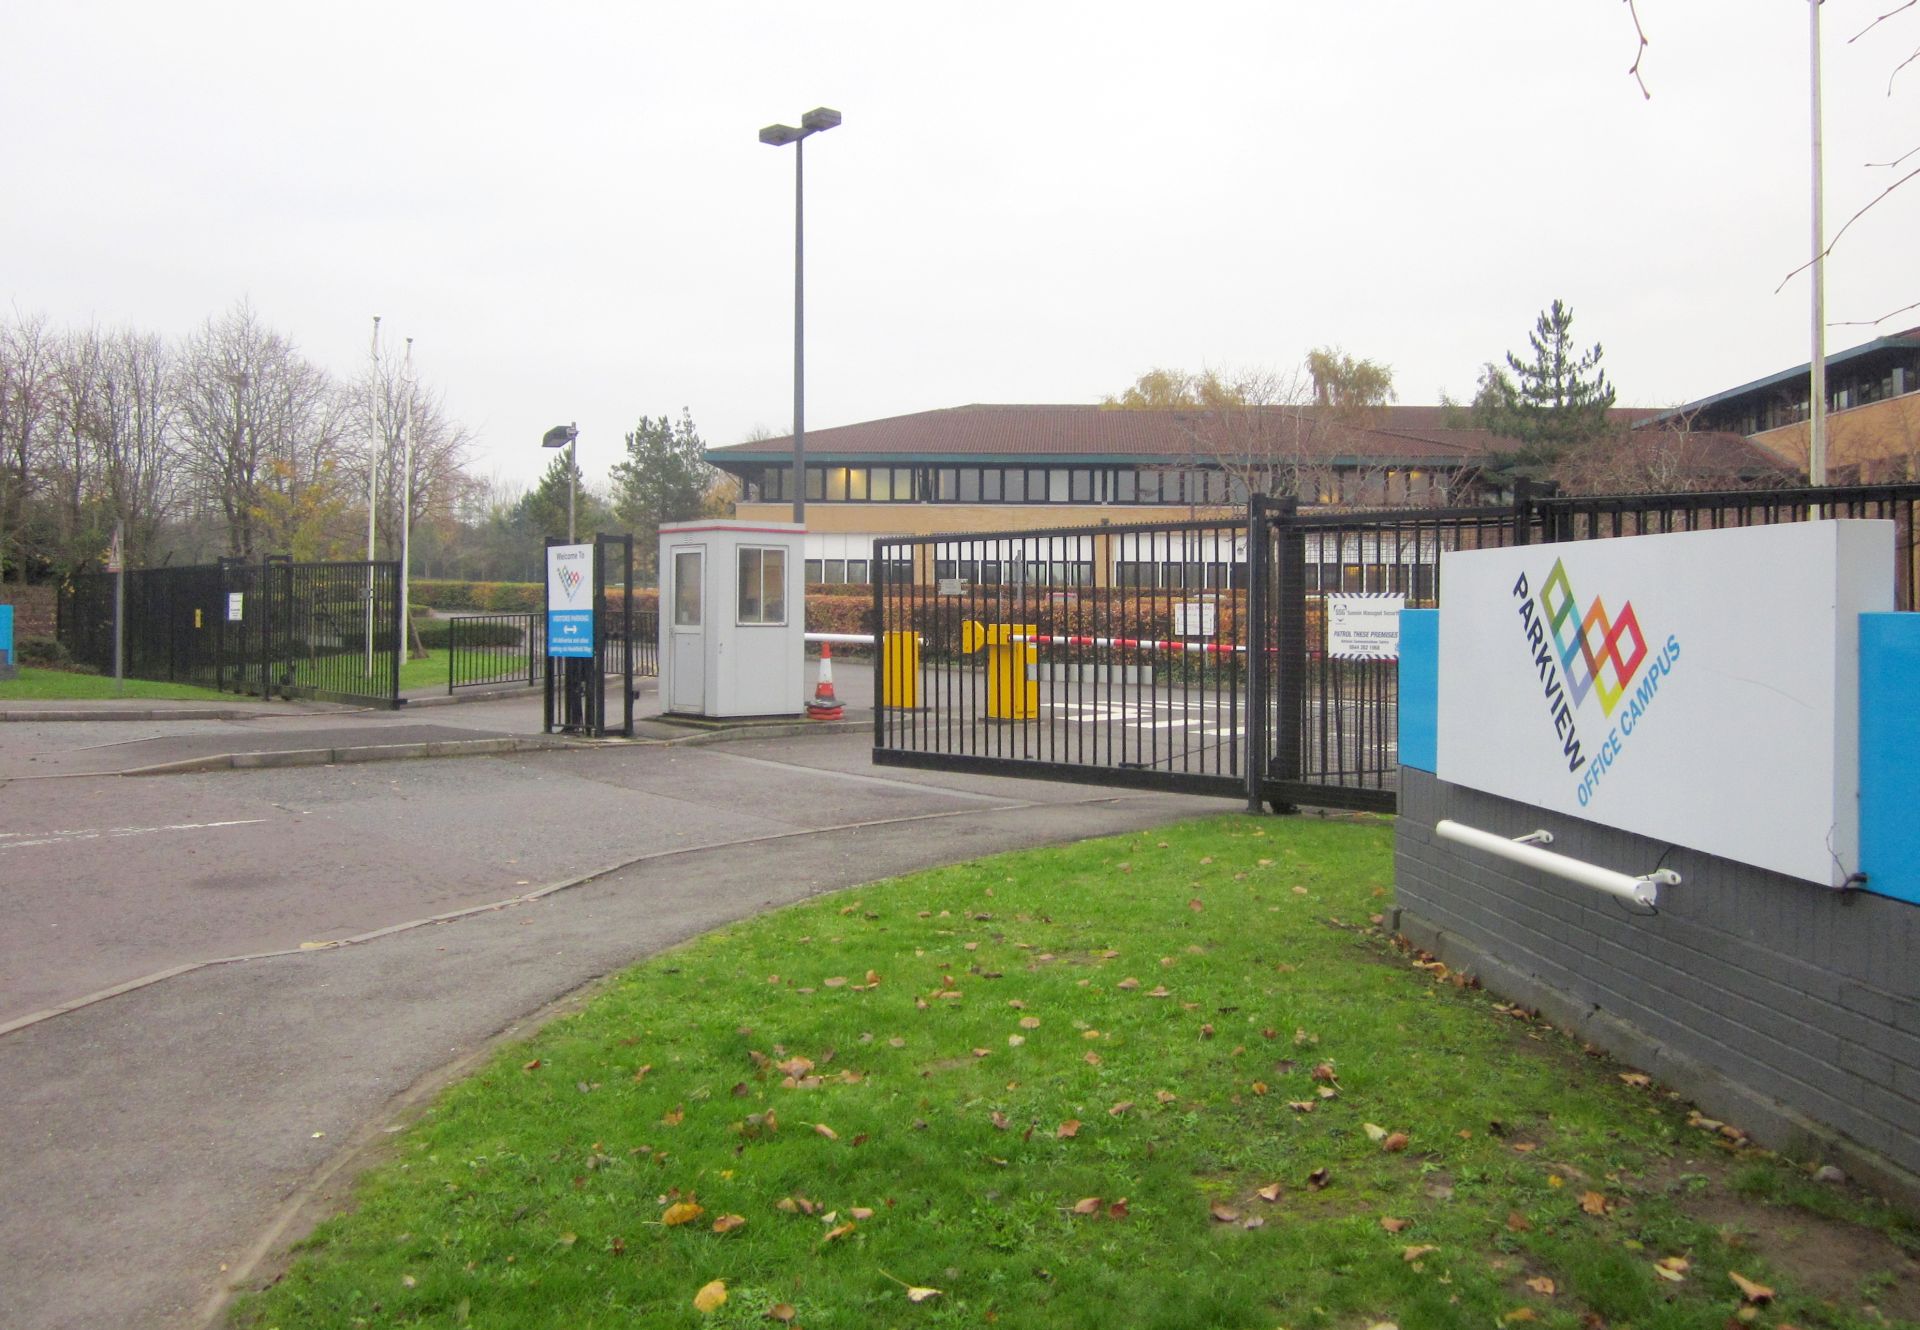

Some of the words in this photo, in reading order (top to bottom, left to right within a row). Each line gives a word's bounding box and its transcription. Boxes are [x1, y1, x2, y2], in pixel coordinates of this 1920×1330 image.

[556, 551, 578, 561] Welcome
[578, 550, 585, 560] To
[1334, 630, 1352, 638] PATROL
[1370, 631, 1399, 639] PREMISES
[1512, 571, 1586, 773] PARKVIEW
[1577, 727, 1623, 807] OFFICE
[1620, 635, 1681, 737] CAMPUS
